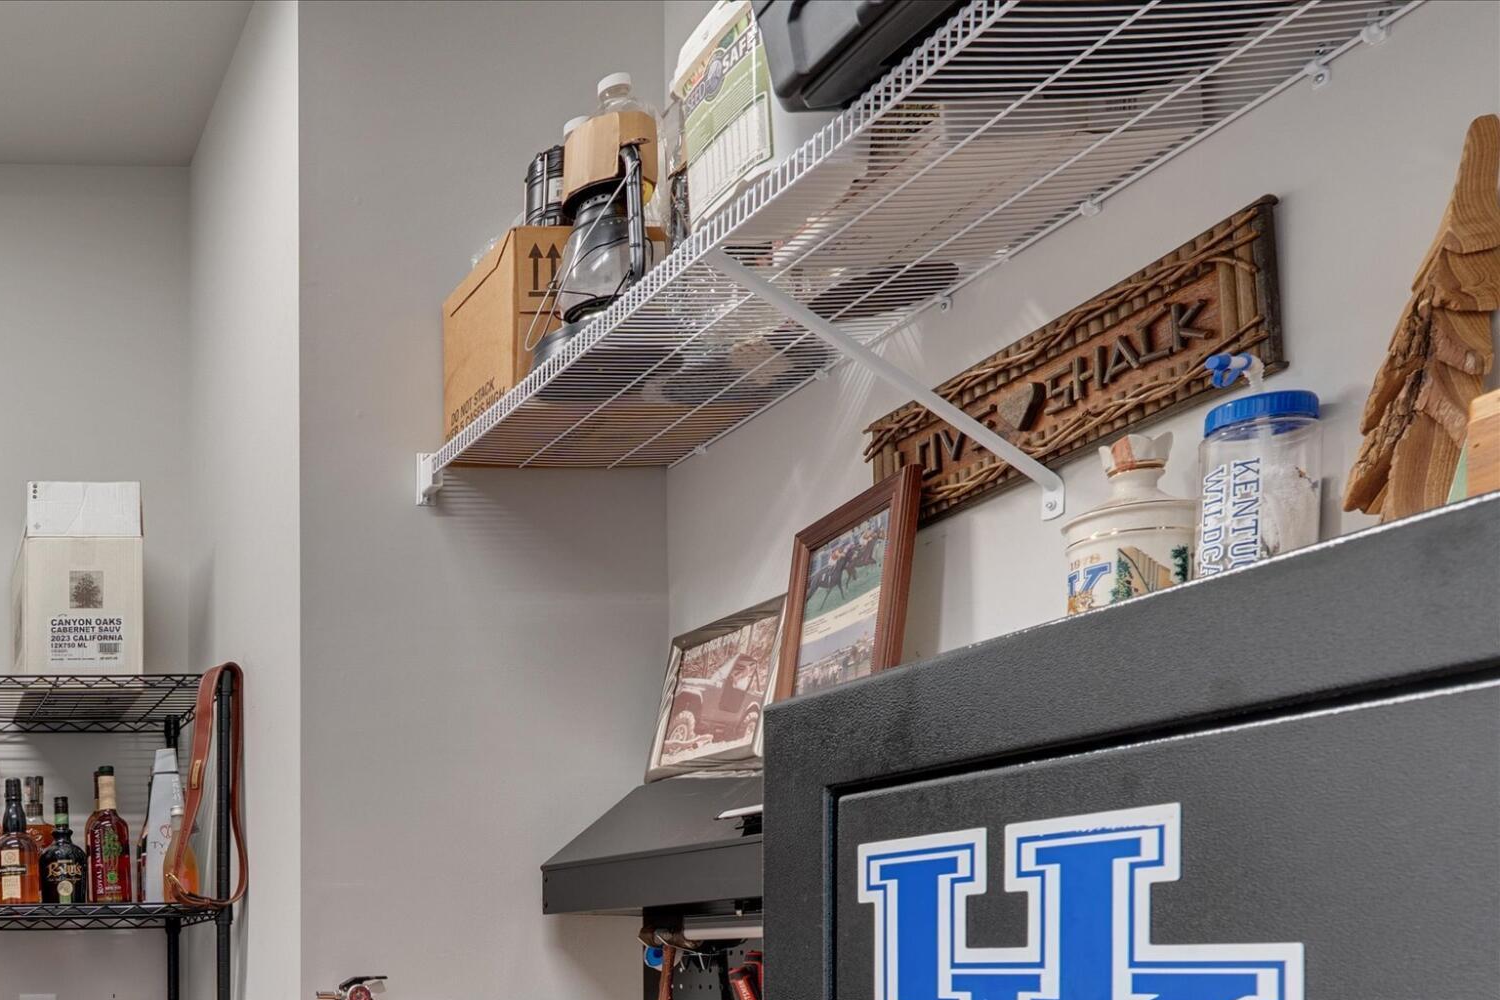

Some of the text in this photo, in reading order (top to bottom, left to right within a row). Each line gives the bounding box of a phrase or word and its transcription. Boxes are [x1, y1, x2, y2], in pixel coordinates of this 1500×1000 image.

[722, 31, 761, 75] SAFE
[1044, 300, 1213, 416] SHACK
[460, 396, 473, 418] NOT
[474, 376, 496, 406] STACK
[1227, 457, 1262, 569] KENTU
[51, 618, 122, 626] CANYON OAKS
[51, 626, 96, 634] CABERNET
[72, 634, 123, 642] CALIFORNIA
[96, 870, 105, 895] ROYAL
